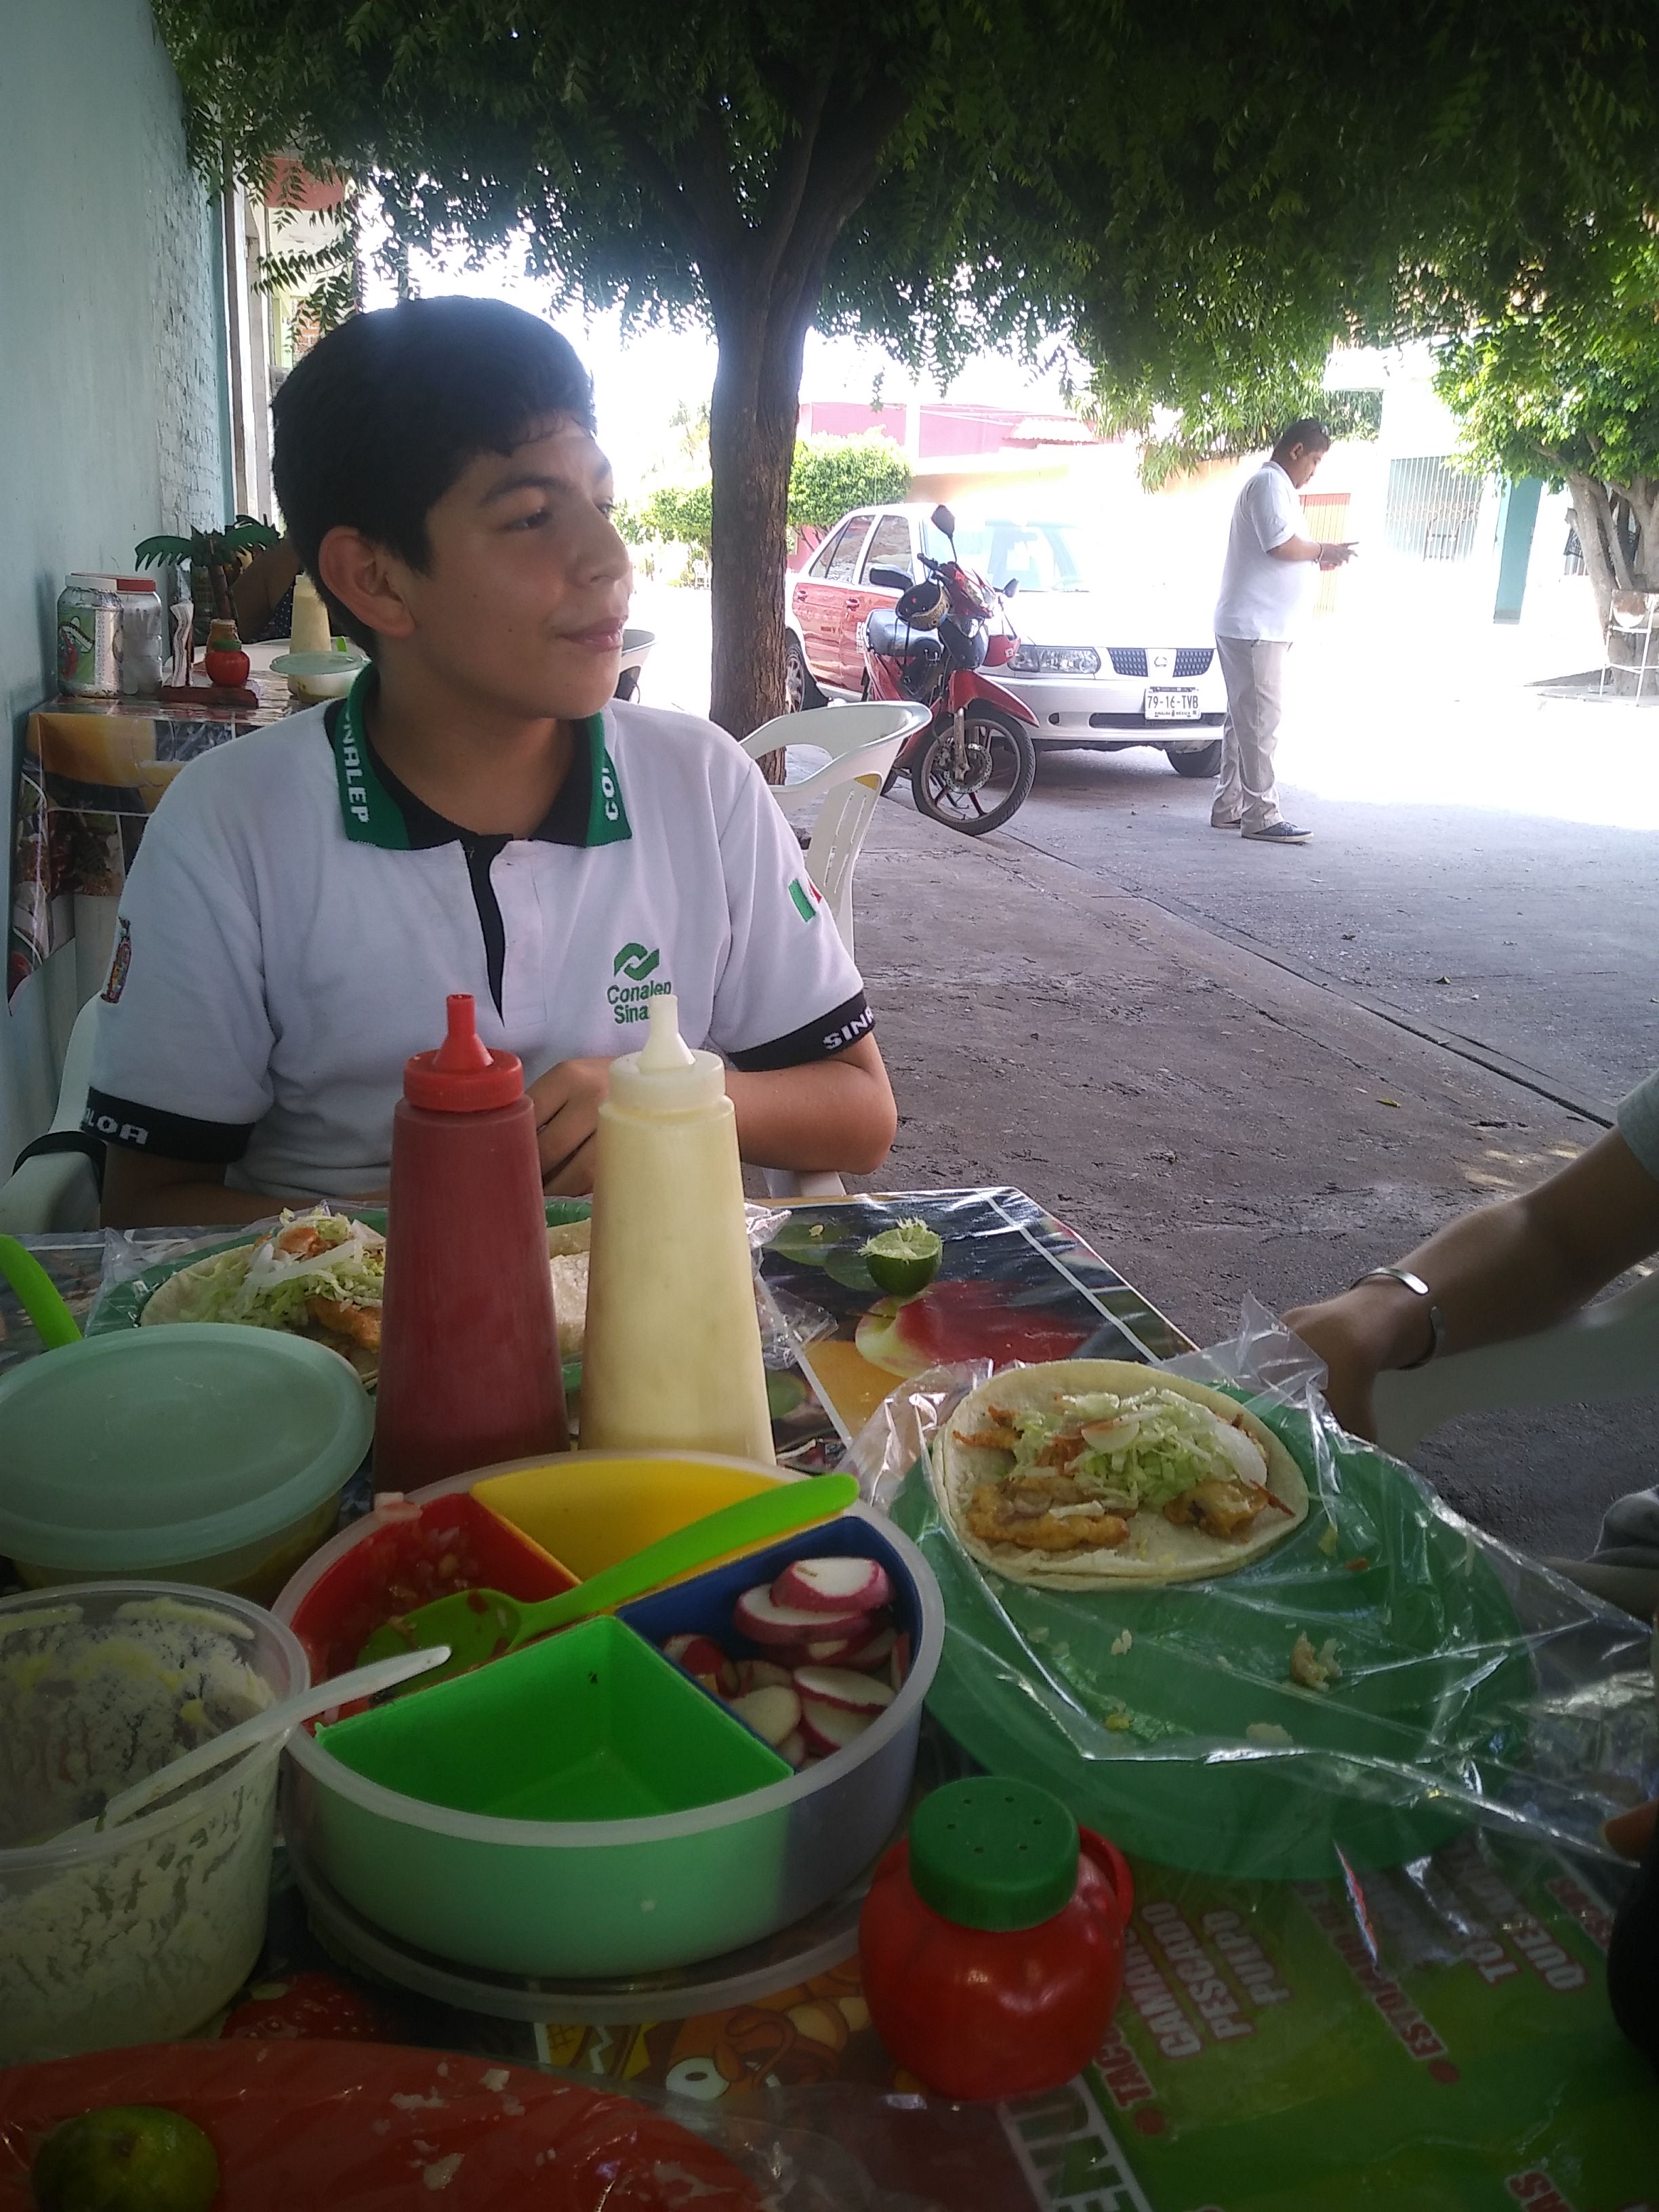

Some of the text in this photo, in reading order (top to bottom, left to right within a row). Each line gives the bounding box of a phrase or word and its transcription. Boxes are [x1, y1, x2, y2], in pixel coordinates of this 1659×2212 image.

[1147, 695, 1199, 709] 79-16-TVB
[607, 980, 672, 1005] Conalep
[613, 1004, 649, 1024] Sina
[1201, 1909, 1291, 2006] PULPO
[1141, 1902, 1254, 2040] PESCADO
